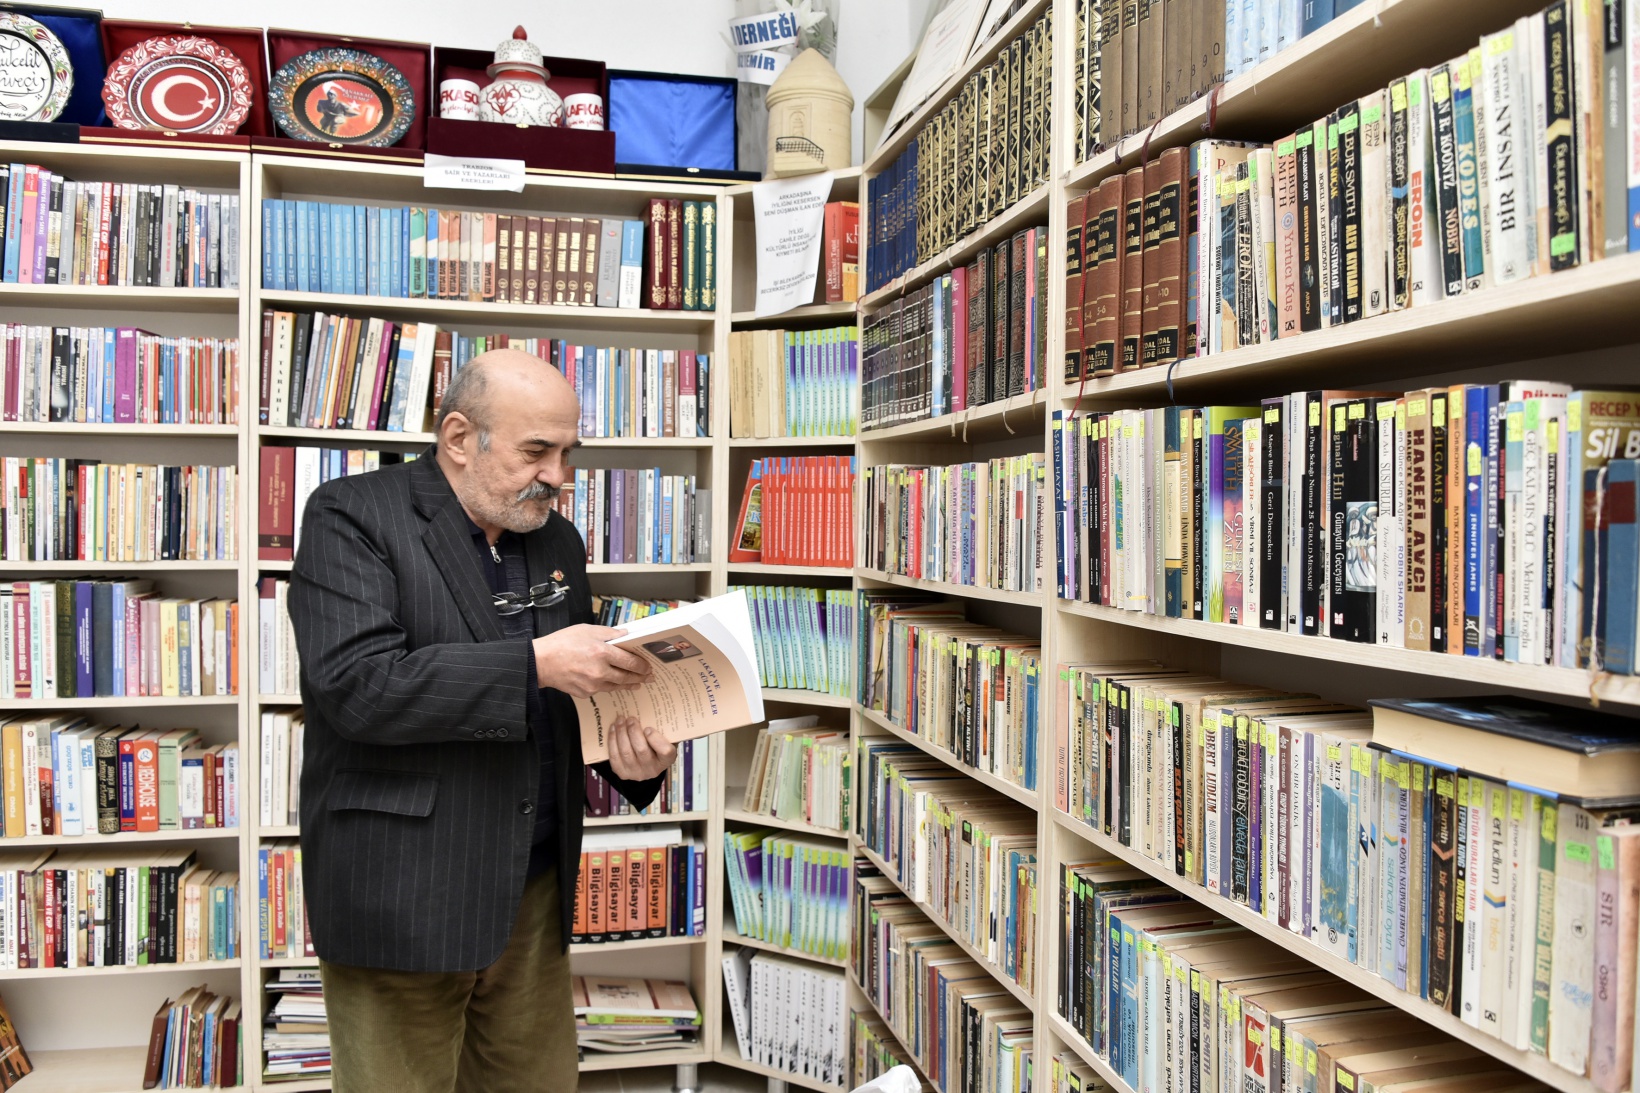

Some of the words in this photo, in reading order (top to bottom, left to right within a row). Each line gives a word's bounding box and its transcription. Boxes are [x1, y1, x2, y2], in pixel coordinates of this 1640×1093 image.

[734, 12, 797, 45] DERNEĞİ
[1395, 136, 1406, 181] clausen
[1495, 104, 1513, 181] İNSAN
[1441, 134, 1456, 190] KOONTZ
[779, 191, 812, 200] ARKADAŞINA
[793, 196, 820, 204] KESERSEN
[1330, 167, 1338, 199] KOÇAK
[1344, 170, 1356, 218] SMITH
[1458, 141, 1478, 230] KODES
[777, 207, 799, 215] DÜŞMAN
[1497, 190, 1516, 232] BİR
[101, 231, 109, 244] CHP
[766, 244, 791, 252] KÜLTÜRLÜ
[779, 235, 797, 243] CAHİLE
[1346, 224, 1357, 251] ALEV
[1445, 208, 1459, 255] NÖBET
[1239, 232, 1251, 281] EROİN
[1283, 230, 1294, 280] Yırtıcı
[1331, 242, 1340, 290] ASTROLOJİ
[1396, 244, 1407, 280] çatlak
[1346, 251, 1359, 299] KIYILARI
[1283, 283, 1294, 312] Kuş
[665, 376, 673, 398] TRABZON
[1590, 402, 1630, 416] RECEP
[1488, 407, 1500, 458] EĞİTİM
[1523, 430, 1535, 462] GEÇ
[1586, 428, 1620, 458] Sil
[1193, 464, 1201, 487] Binchy
[1223, 426, 1237, 491] SMITH
[1266, 460, 1274, 486] Binchy
[1307, 453, 1315, 477] Sokağı
[1413, 429, 1425, 520] HANEFİ
[1432, 426, 1444, 504] GİLGAMEŞ
[1081, 486, 1088, 497] Ne
[1181, 468, 1189, 513] MÜKEMMEL
[1333, 473, 1345, 501] Hill
[1380, 462, 1391, 516] SUSURLUK
[1488, 460, 1499, 529] FELSEFESİ
[1524, 465, 1536, 519] KALMIŞ
[1181, 517, 1189, 541] LİNDA
[1308, 510, 1315, 520] 25
[1333, 511, 1344, 550] Günaydın
[1193, 529, 1201, 562] Yağmurlu
[1223, 520, 1234, 572] ZAFERİ
[1233, 511, 1244, 584] GÜNEŞİN
[1267, 512, 1275, 561] Döneceksin
[1469, 513, 1477, 559] JENNIFER
[1525, 522, 1537, 553] ÖLÜ
[1181, 542, 1189, 576] HOWARD
[1334, 552, 1345, 595] Geceyarısı
[1413, 530, 1426, 593] AVCI
[1434, 552, 1442, 585] HAKAN
[1469, 562, 1477, 592] JAMES
[1522, 561, 1533, 607] Mehmet
[1452, 581, 1460, 626] ÇOCUKLARI
[1521, 610, 1533, 649] Eroğlu
[698, 658, 716, 680] LAKAP
[713, 679, 721, 690] VE
[699, 671, 718, 715] SÜLALELER
[1293, 754, 1300, 770] ON
[138, 767, 156, 808] REDHOUSE
[1174, 767, 1182, 797] KAN
[1206, 771, 1217, 814] LUDLUM
[1174, 799, 1185, 850] ÇANAĞI
[1292, 790, 1300, 828] DAKİKA
[1469, 808, 1480, 836] BÜTÜN
[1235, 817, 1248, 854] elveda
[1348, 803, 1358, 862] Psikolojisi
[1209, 854, 1219, 875] BÜYÜSÜ
[1233, 855, 1248, 887] janet
[1456, 844, 1466, 868] KING
[1469, 838, 1479, 886] KURALLARI
[1490, 839, 1503, 885] ludlum
[45, 878, 54, 907] ATATÜRK
[275, 867, 284, 897] Bilgisayar
[589, 868, 601, 925] Bilgisayar
[608, 866, 620, 923] Bilgisayar
[628, 862, 641, 920] Bilgisayar
[649, 863, 661, 920] Bilgisayar
[1348, 863, 1357, 906] Kitleler
[1385, 857, 1396, 916] sakıncalı
[1455, 878, 1466, 923] DOLORES
[1468, 887, 1477, 912] YIKIN
[45, 908, 53, 916] VE
[45, 917, 53, 928] CHP
[276, 898, 284, 913] Kurs
[1600, 891, 1613, 928] SIR
[1085, 931, 1093, 961] KALE
[1383, 918, 1395, 951] oyun
[1488, 916, 1500, 952] takas
[1085, 981, 1093, 1002] DAN
[1598, 964, 1609, 1002] OSHO
[1085, 1003, 1093, 1042] BROWN
[1190, 1009, 1198, 1039] LAYMON
[1191, 1050, 1199, 1086] ÇILDIRTAN
[1203, 1032, 1211, 1075] SMITH
